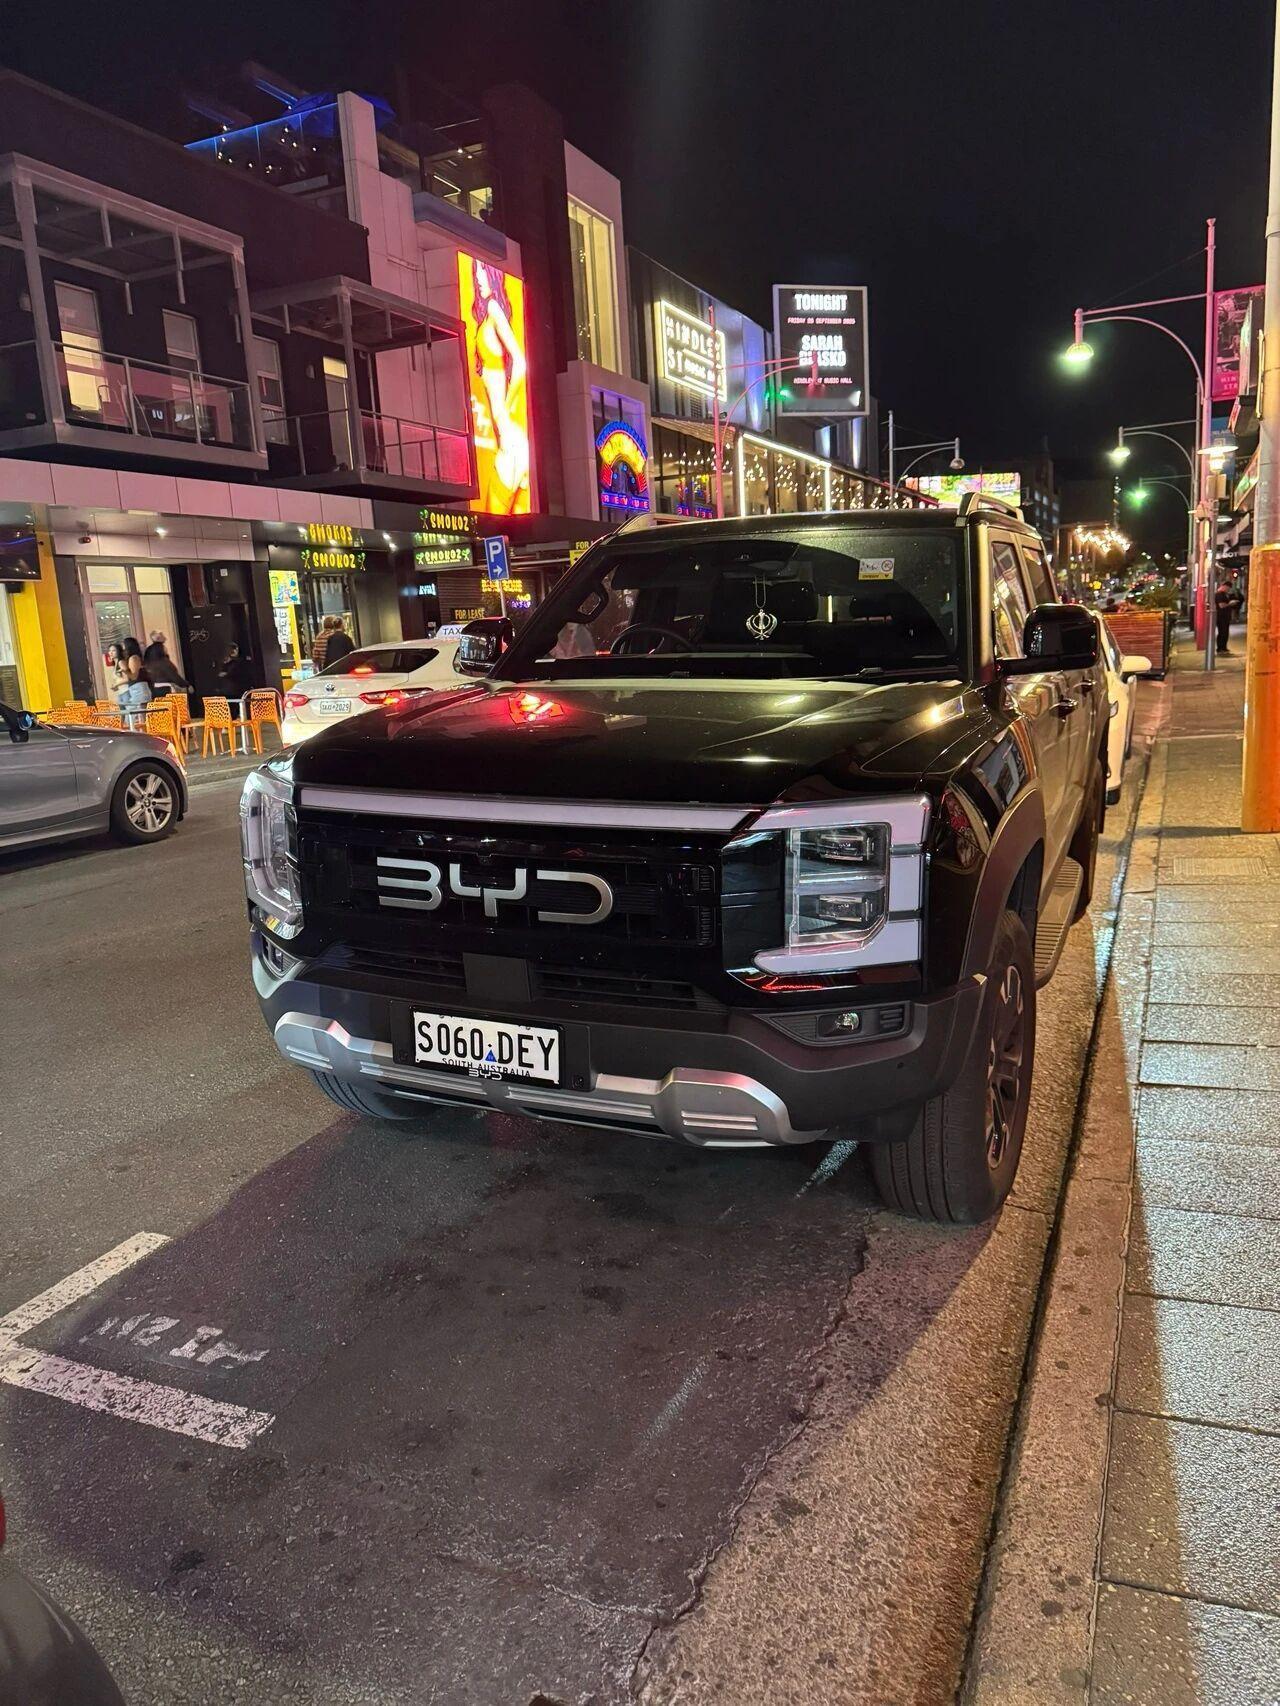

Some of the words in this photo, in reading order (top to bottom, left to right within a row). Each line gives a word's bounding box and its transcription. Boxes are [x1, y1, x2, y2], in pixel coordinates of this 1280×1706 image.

[795, 294, 847, 311] TONIGHT
[802, 335, 843, 351] SARAH
[668, 347, 682, 373] ST
[603, 494, 649, 509] REVUE
[430, 512, 470, 531] SMOKOZ
[489, 541, 502, 562] P
[576, 541, 590, 550] FOR
[313, 552, 356, 569] SMOKOZ
[424, 548, 462, 562] SMOKOZ
[455, 609, 467, 619] FOR
[468, 608, 485, 619] LEASE
[377, 856, 613, 924] BYD
[497, 1031, 555, 1071] DEY
[442, 1058, 473, 1069] SOUTH
[478, 1063, 531, 1078] AUSTRALIA
[469, 1068, 502, 1080] BYD
